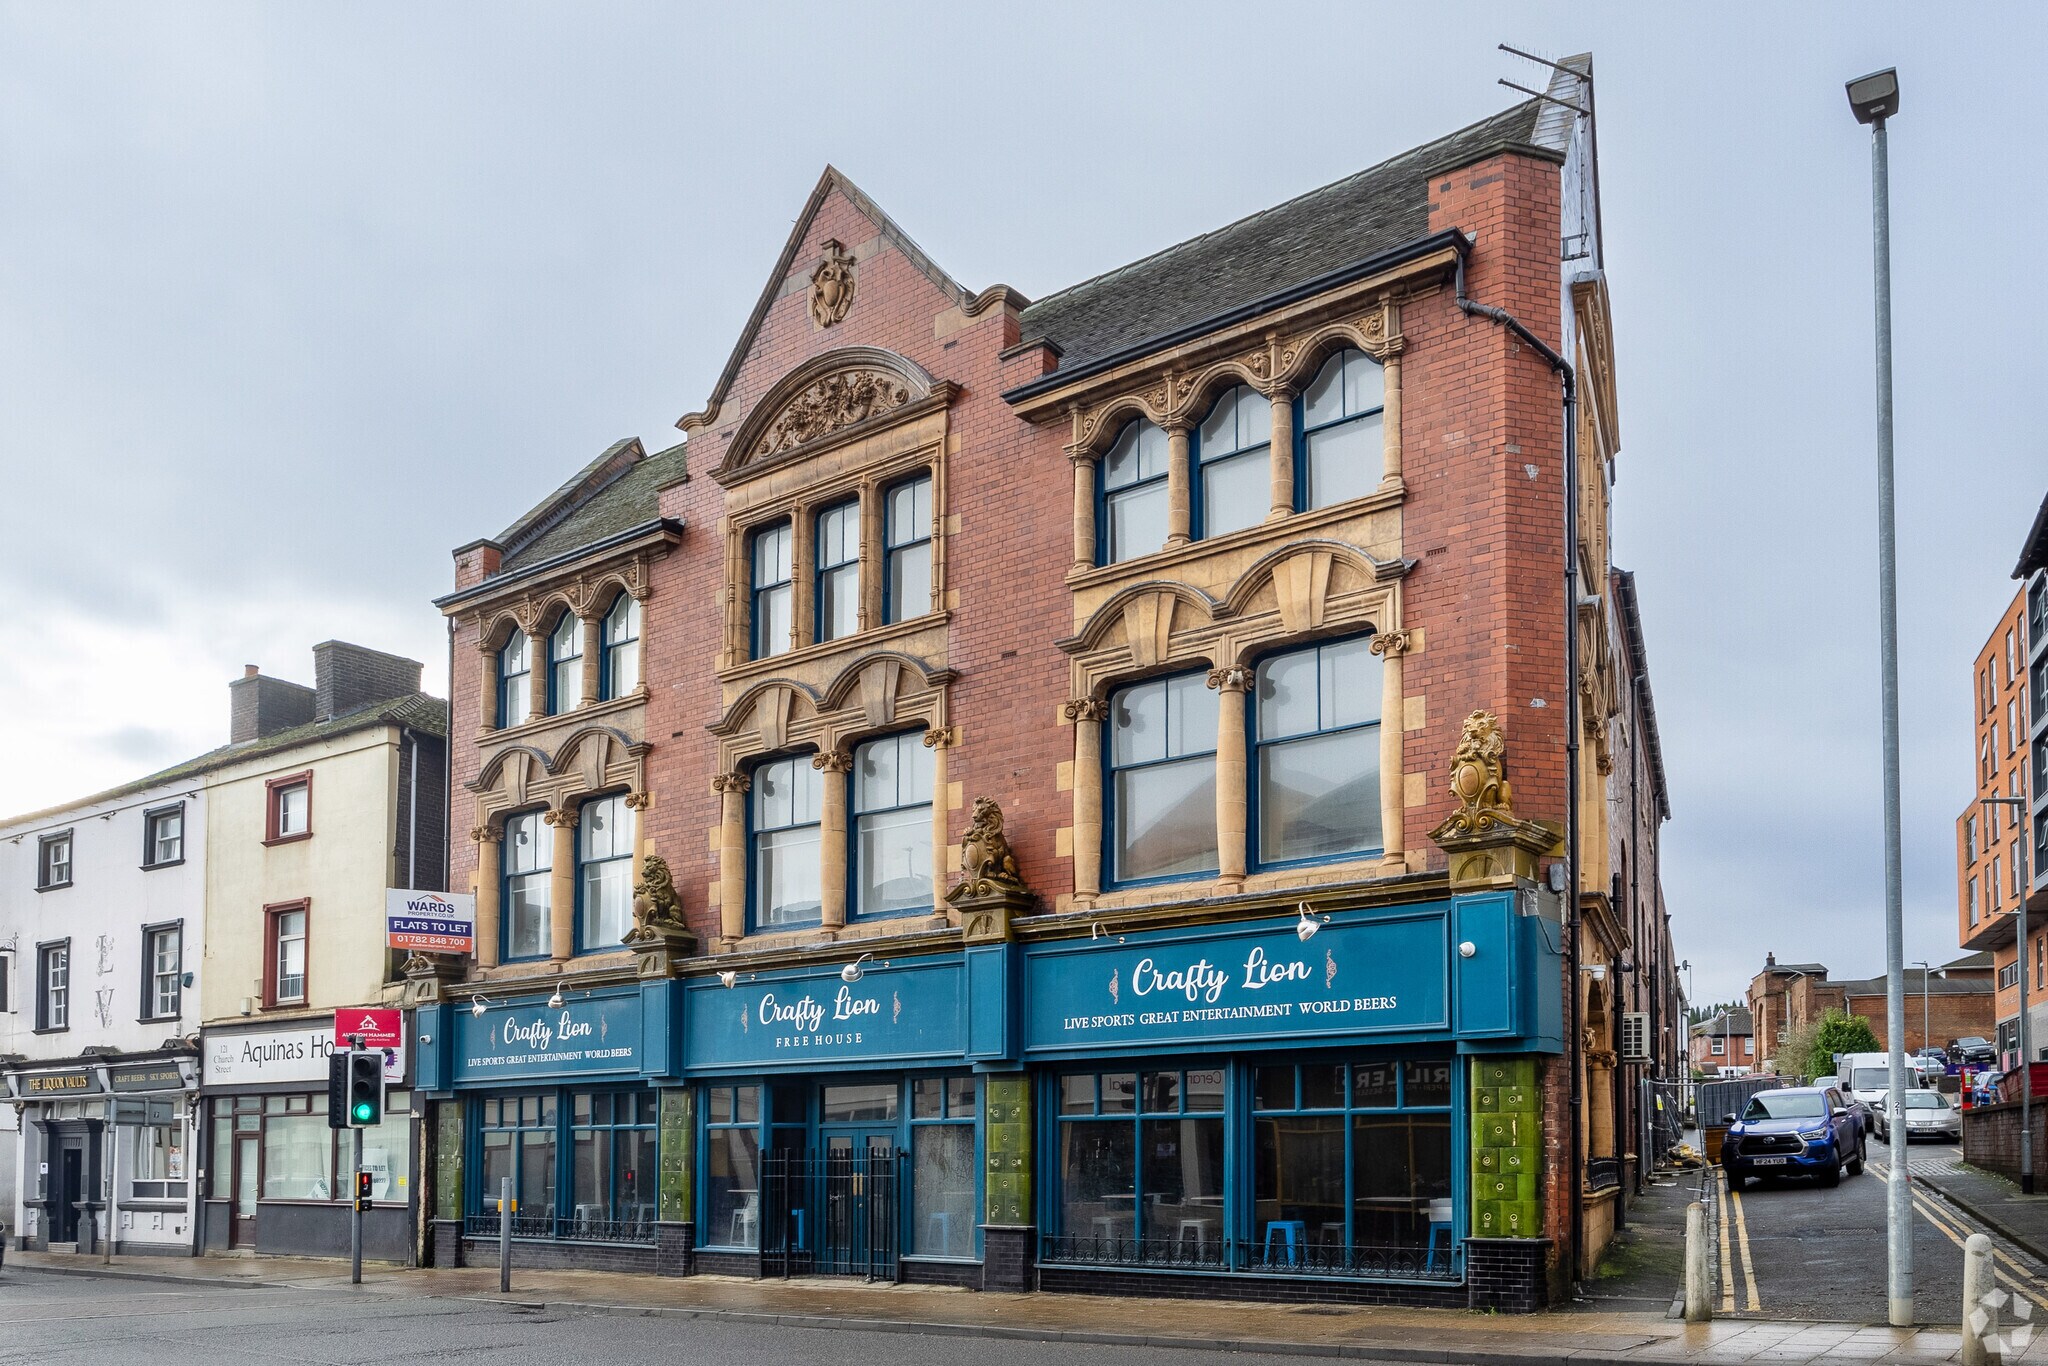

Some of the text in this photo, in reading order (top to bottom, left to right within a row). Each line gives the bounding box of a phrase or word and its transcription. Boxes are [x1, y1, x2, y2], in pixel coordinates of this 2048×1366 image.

[407, 901, 454, 913] WARDS
[394, 921, 468, 933] FLATS TO LET
[397, 935, 428, 943] 01782
[429, 937, 447, 945] 848
[448, 938, 465, 946] 700
[1132, 946, 1312, 1003] Crafty Lion
[759, 985, 880, 1032] Crafty Lion
[1064, 996, 1397, 1030] LIVE SPORTS GREAT ENTERTAINMENT WORLD BEERS
[503, 1010, 592, 1050] Crafty Lion
[775, 1032, 863, 1047] FREE HOUSE
[220, 1045, 228, 1053] 121
[241, 1038, 304, 1067] Aquinas
[213, 1054, 234, 1064] Church
[468, 1048, 632, 1067] LIVE SPORTS GREAT ENTERTAINMENT WORLD BEERS
[215, 1065, 232, 1074] Street
[28, 1075, 87, 1091] THE LIQUOR VAULTS
[114, 1071, 179, 1083] CRAFT BEERS SKY SPORTS
[1894, 1101, 1900, 1115] 21
